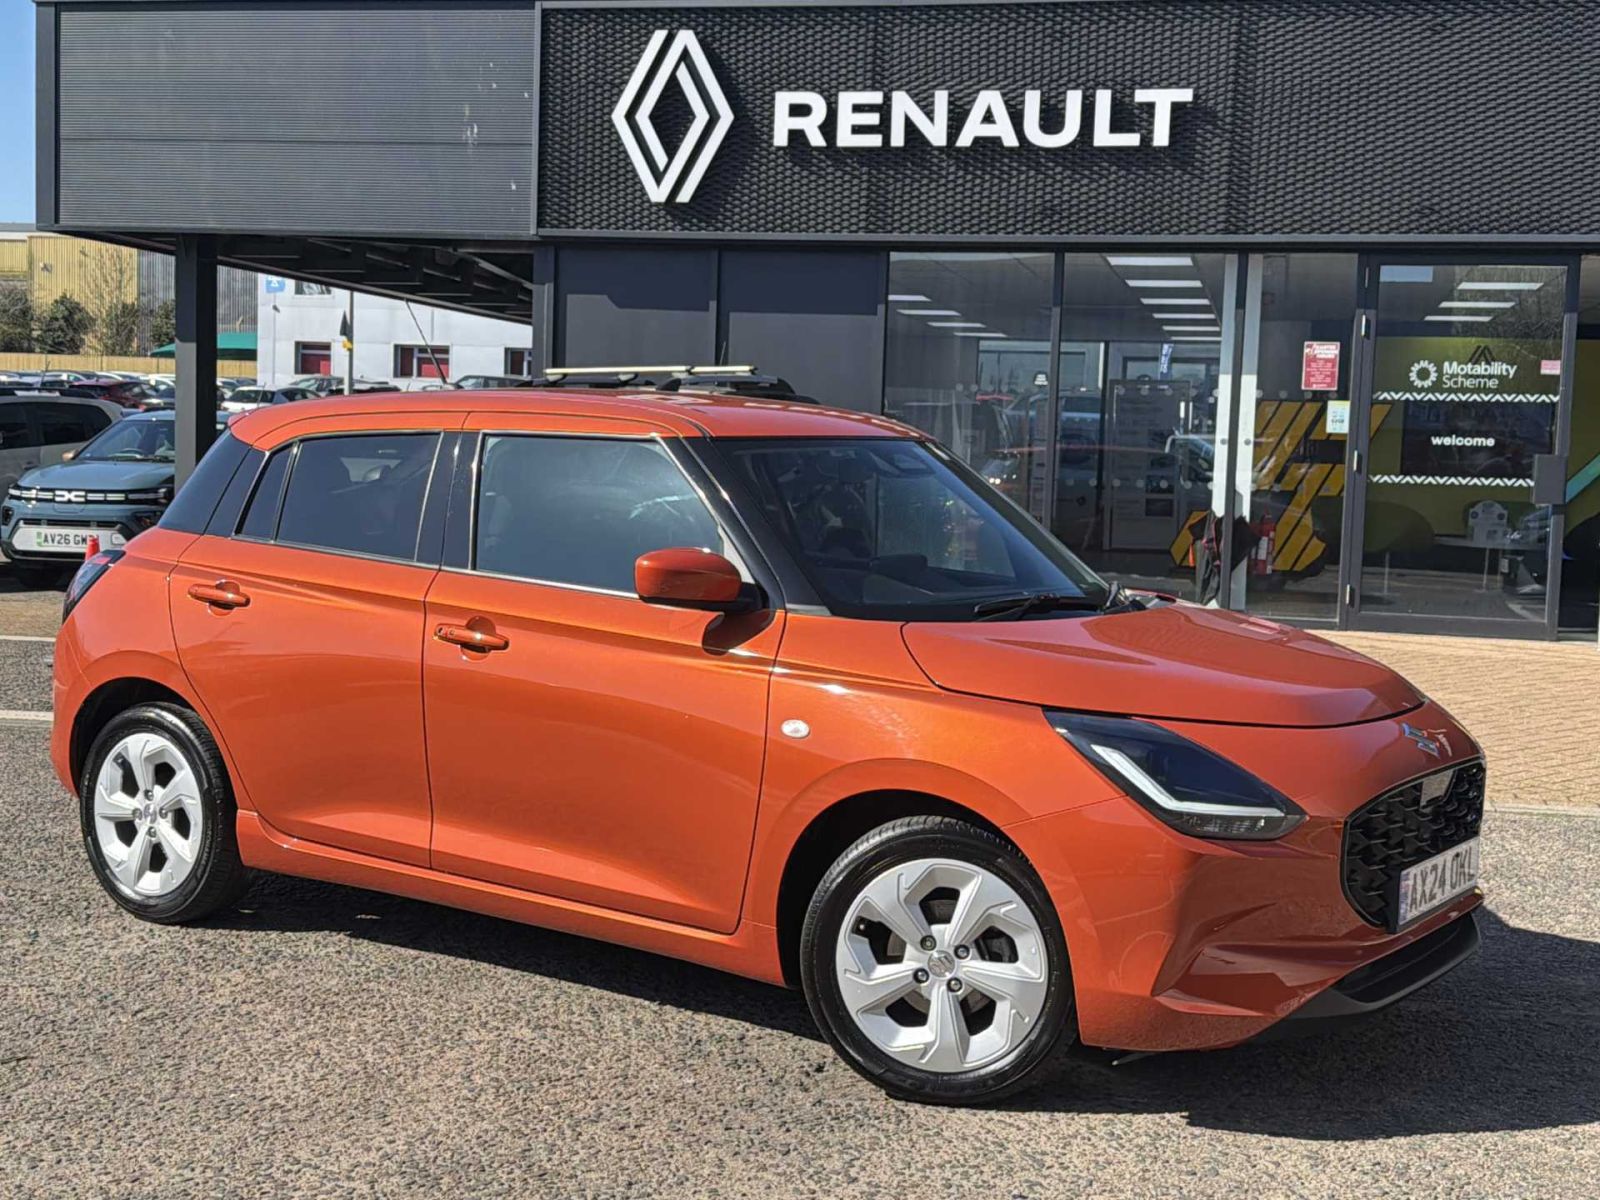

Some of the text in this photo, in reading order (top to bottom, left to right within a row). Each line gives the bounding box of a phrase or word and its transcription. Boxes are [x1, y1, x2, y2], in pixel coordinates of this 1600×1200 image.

[773, 88, 1194, 148] RENAULT
[1442, 361, 1518, 379] Motability
[1442, 375, 1500, 389] Scheme
[1430, 434, 1496, 447] welcome
[43, 533, 71, 546] AV26
[1409, 858, 1447, 913] AX24
